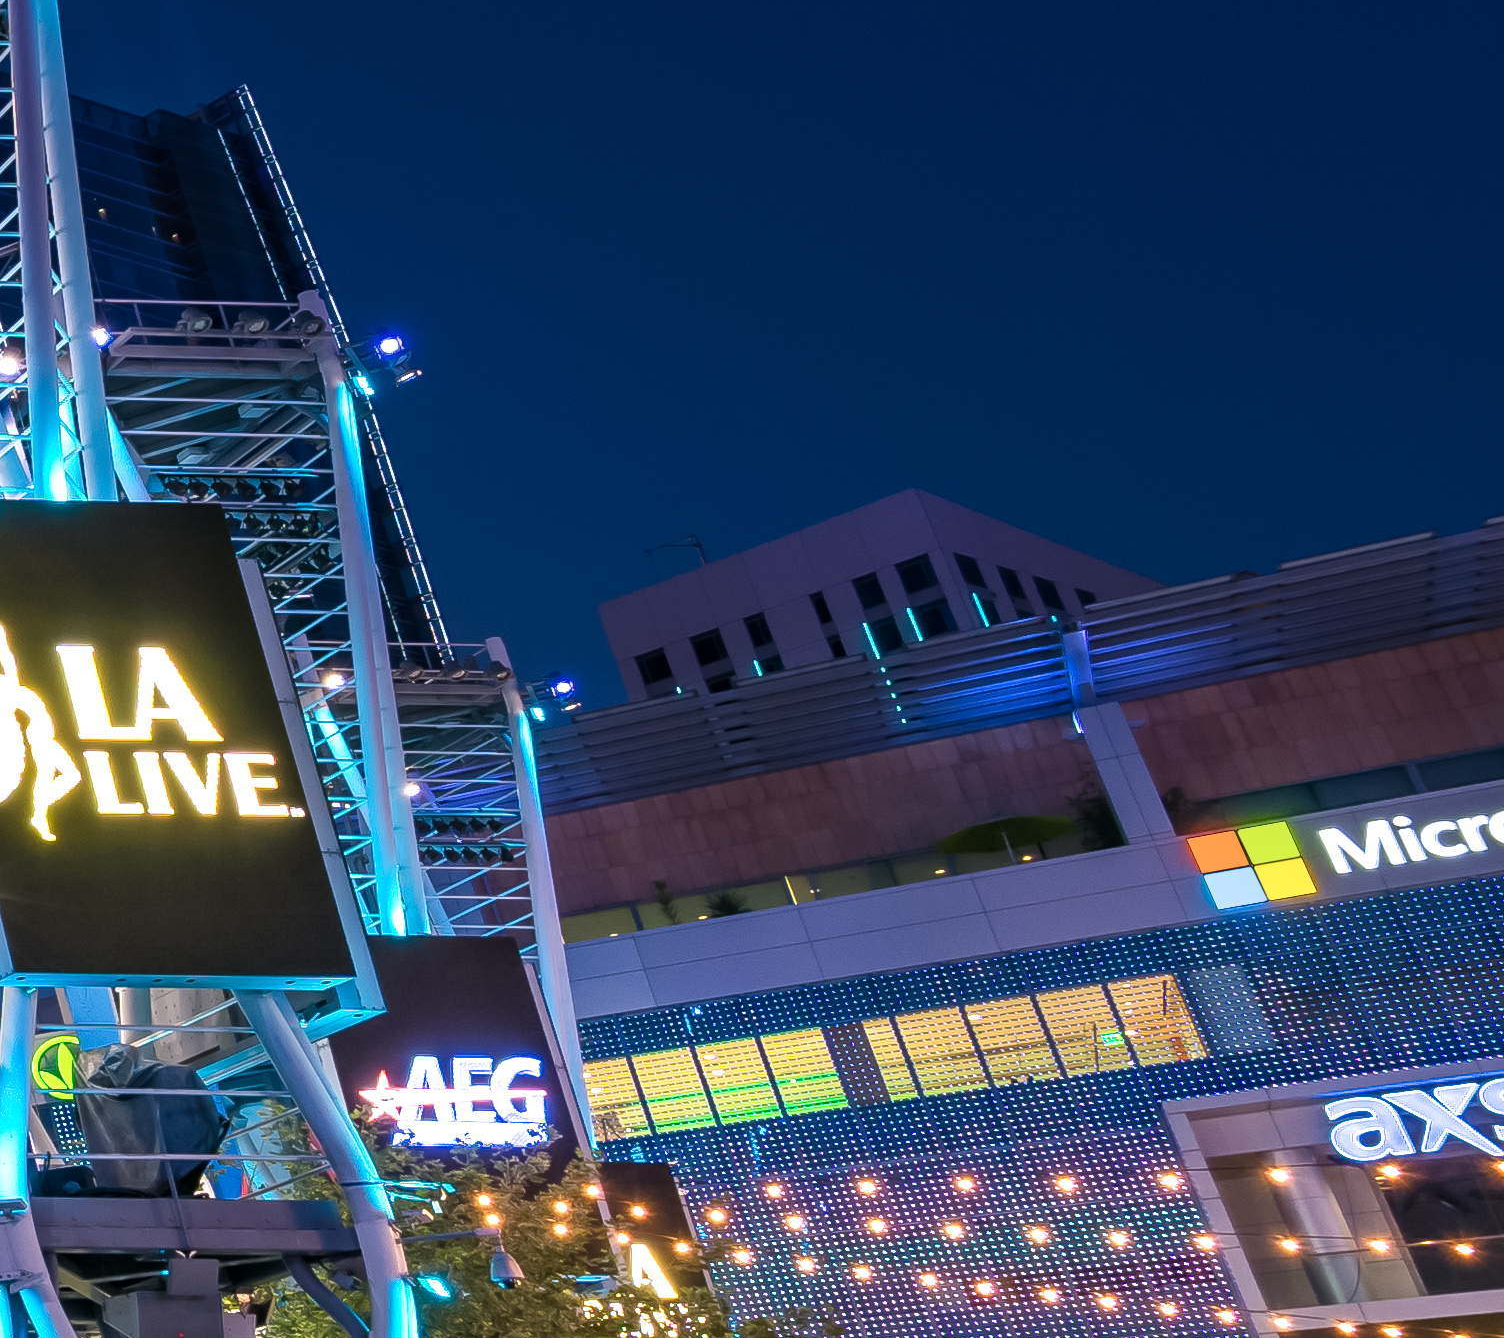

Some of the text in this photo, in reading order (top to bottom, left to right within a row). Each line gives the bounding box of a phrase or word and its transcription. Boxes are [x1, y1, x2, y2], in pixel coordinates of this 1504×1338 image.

[55, 644, 224, 742] LA
[82, 749, 290, 818] LIVE
[397, 1055, 548, 1124] AEG
